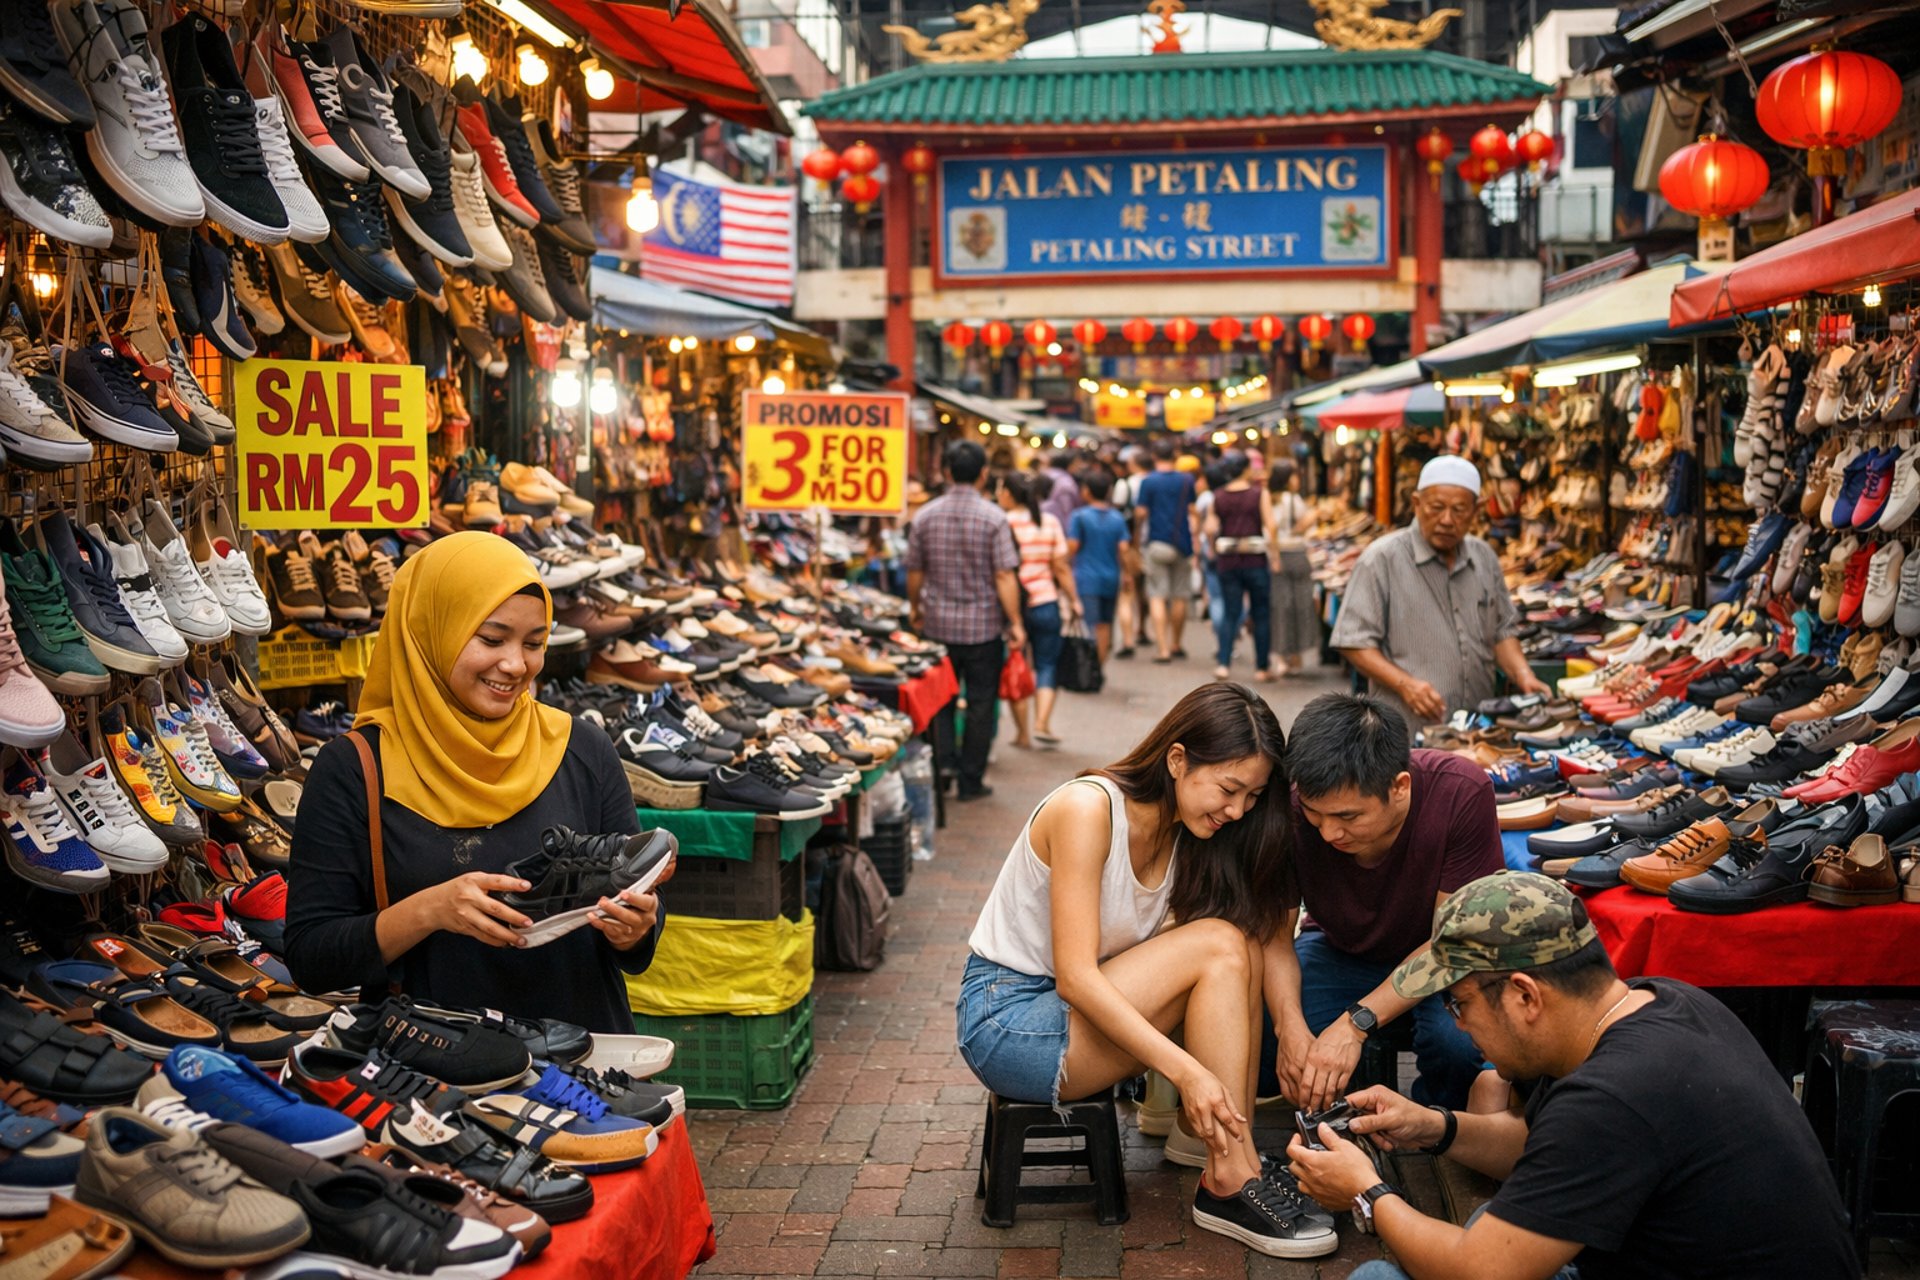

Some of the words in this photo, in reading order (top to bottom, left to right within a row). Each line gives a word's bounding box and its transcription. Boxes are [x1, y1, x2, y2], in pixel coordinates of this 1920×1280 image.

[968, 163, 1113, 200] JALAN
[1130, 156, 1357, 196] PETALING
[1031, 236, 1176, 263] PETALING
[1186, 233, 1299, 259] STREET
[256, 367, 403, 439] SALE
[759, 403, 890, 427] PROMOSI
[246, 442, 420, 523] RM25
[760, 430, 811, 501] 3
[821, 434, 886, 464] FOR
